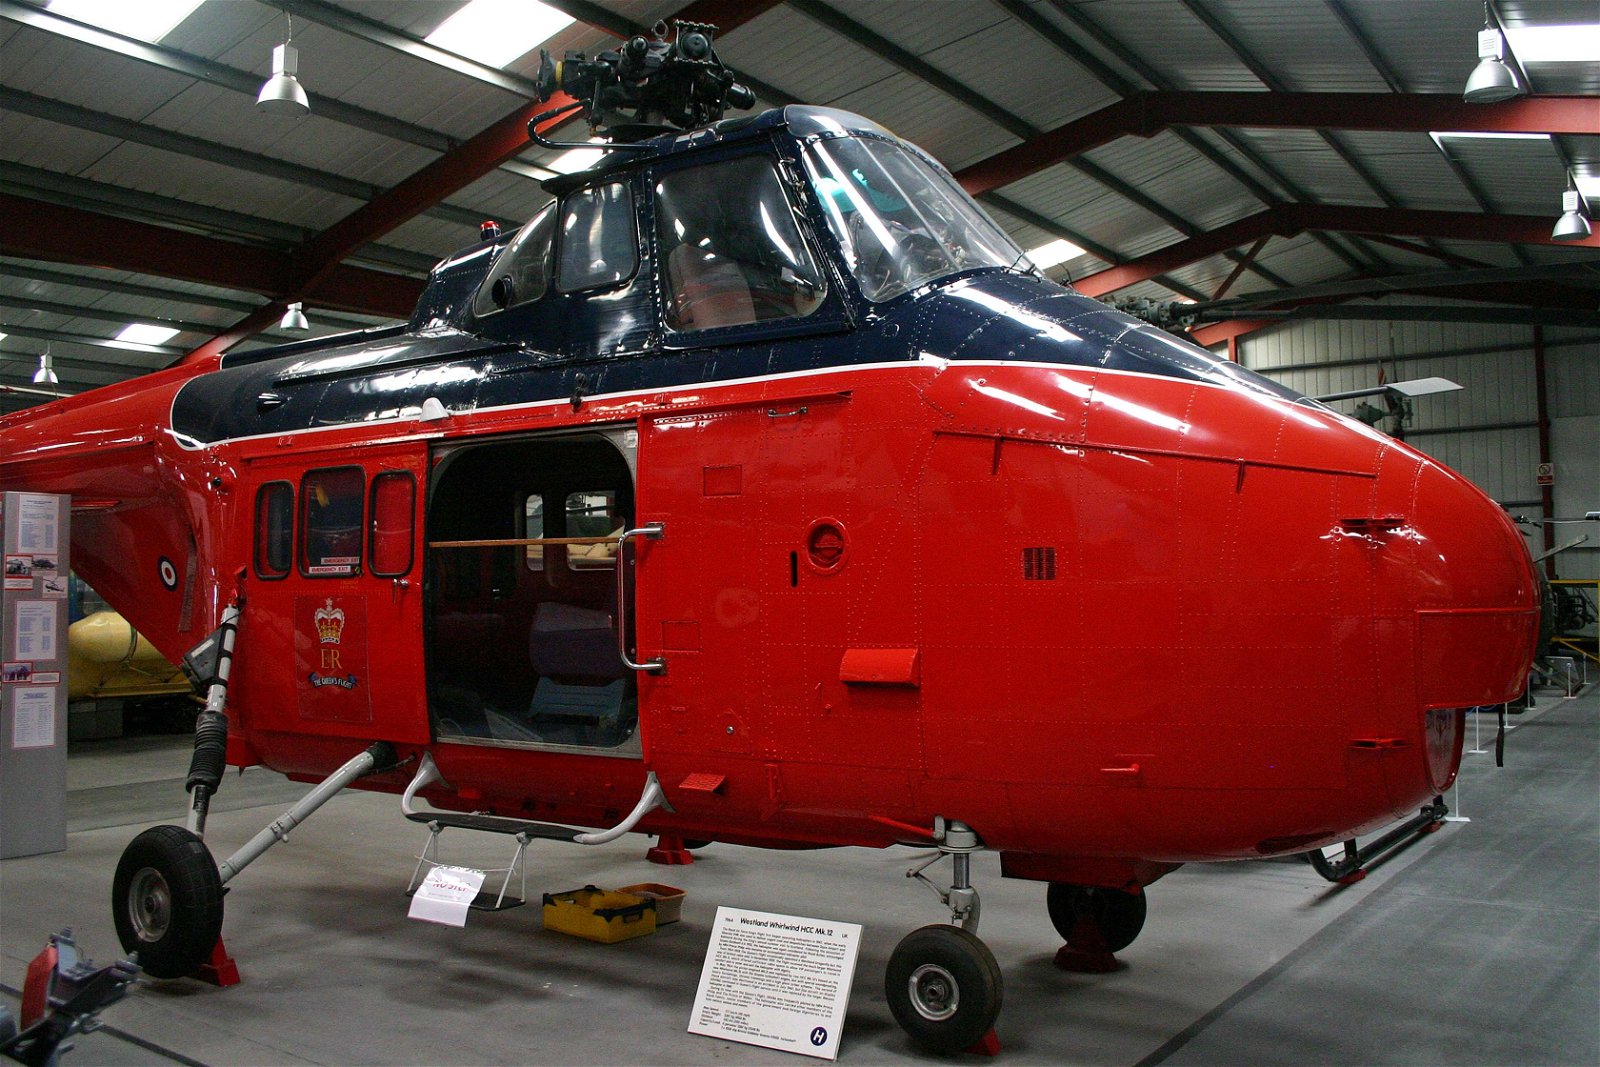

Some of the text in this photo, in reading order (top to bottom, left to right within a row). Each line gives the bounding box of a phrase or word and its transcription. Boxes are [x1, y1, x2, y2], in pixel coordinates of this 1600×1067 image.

[321, 648, 342, 669] ER
[740, 917, 768, 927] Westland
[769, 921, 800, 932] Whirlwind
[800, 925, 815, 934] HCC
